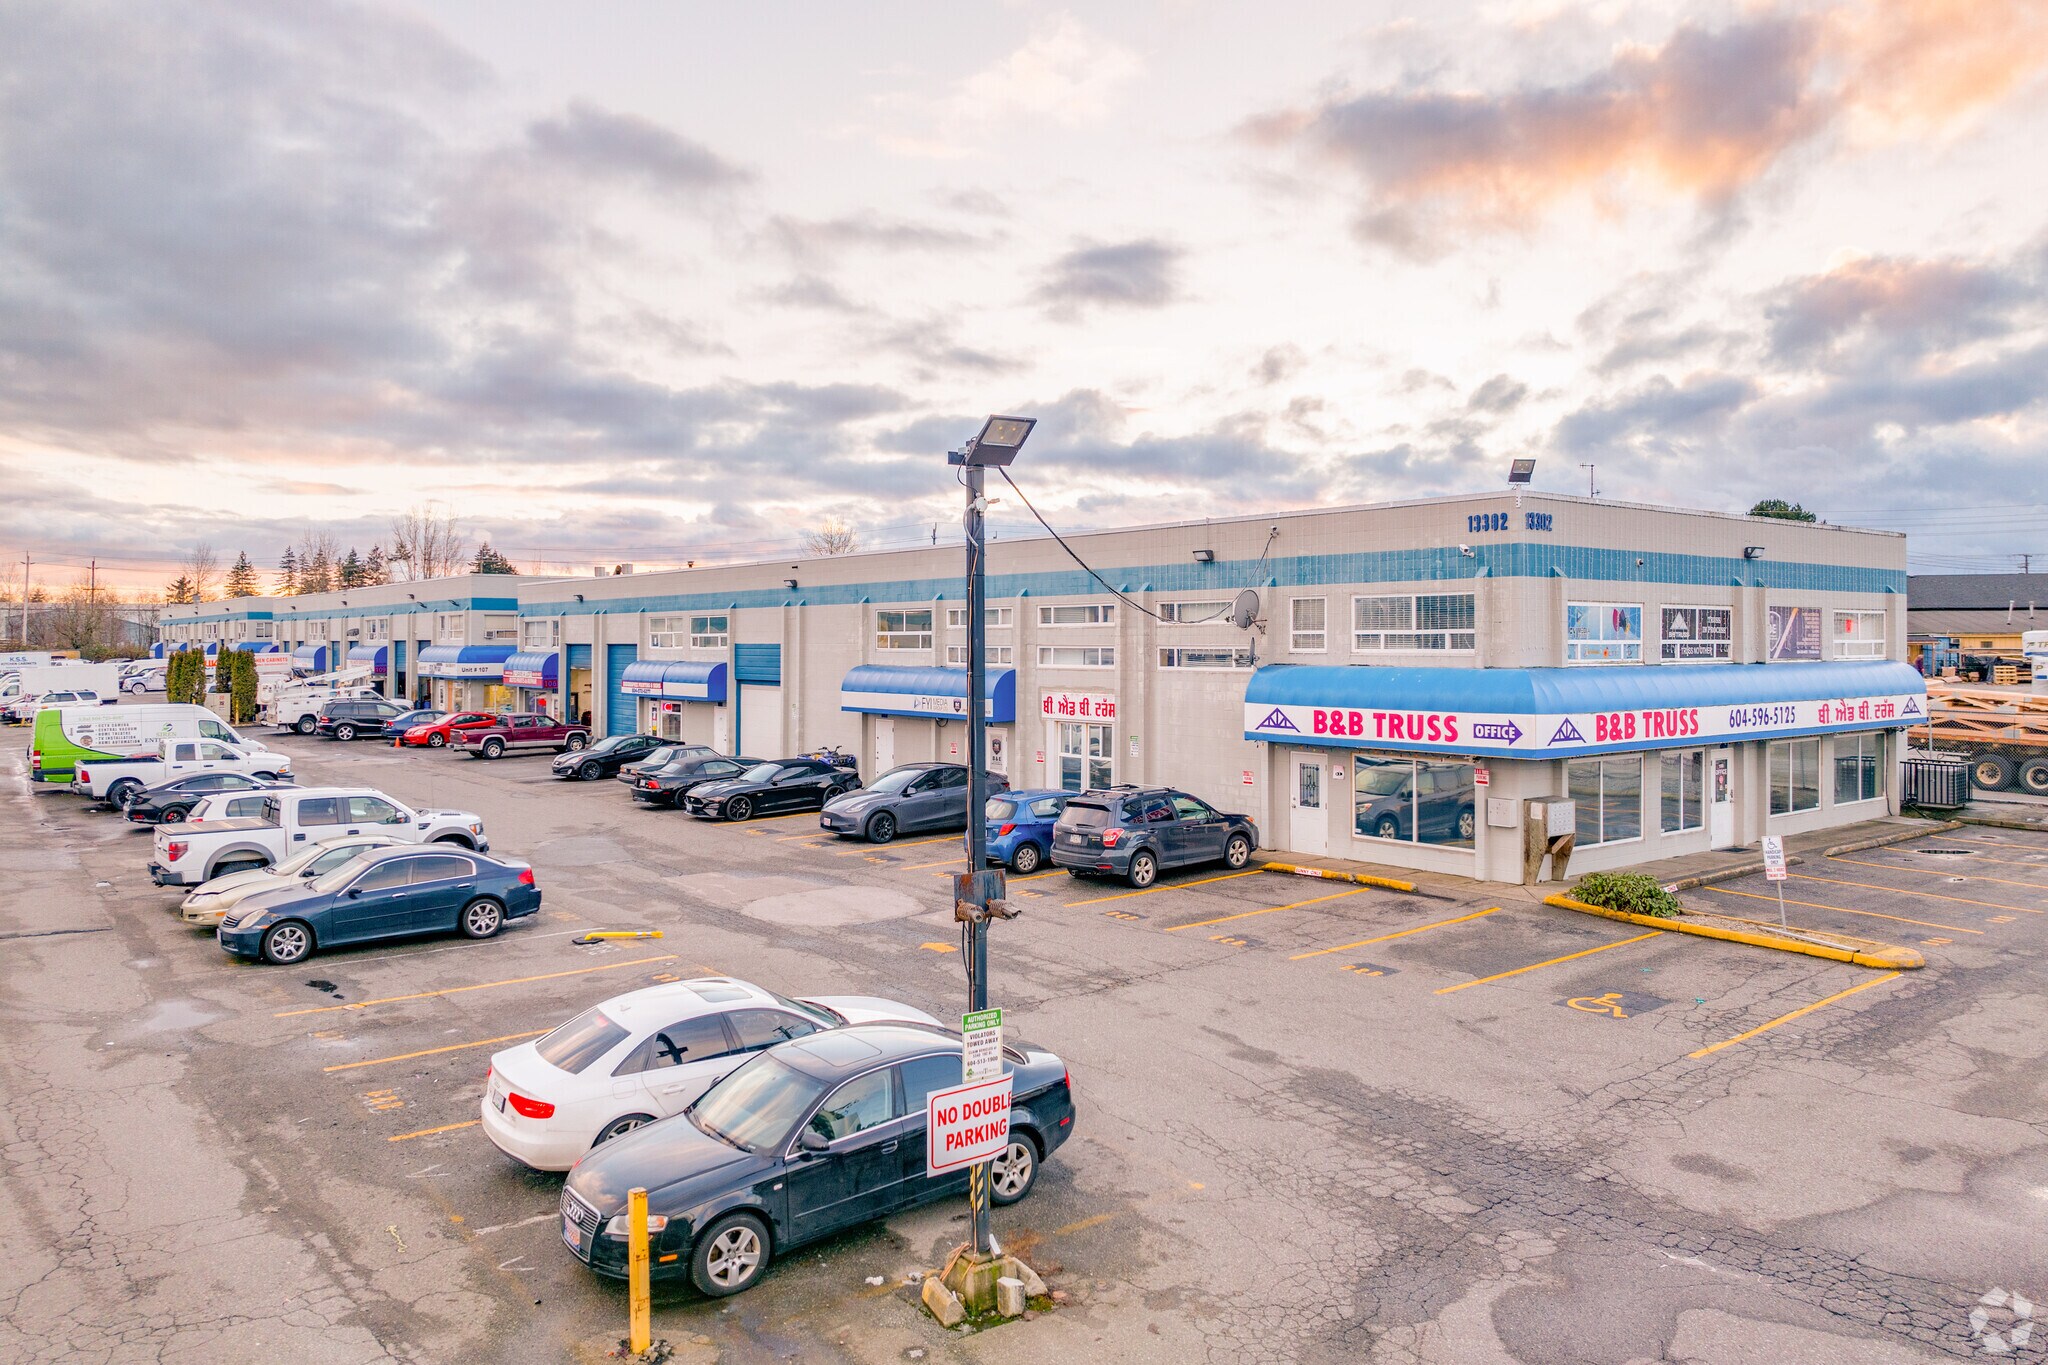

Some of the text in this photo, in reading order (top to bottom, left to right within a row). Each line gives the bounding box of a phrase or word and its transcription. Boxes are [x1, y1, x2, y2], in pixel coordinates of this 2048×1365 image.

[1467, 512, 1509, 533] 13302
[1525, 512, 1553, 532] 13302
[1313, 709, 1459, 743] B&B TRUSS
[1595, 708, 1699, 743] B&B TRUSS
[1729, 706, 1796, 728] 604-596-5125
[1475, 724, 1516, 739] OFFICE
[964, 1018, 1000, 1031] PARKING ONLY
[968, 1012, 997, 1023] AUTHORIZED
[966, 1037, 999, 1048] TOWED AWAY
[969, 1030, 996, 1040] VIOLATORS
[937, 1090, 1012, 1128] NO DOUBLE
[945, 1118, 1007, 1152] PARKING
